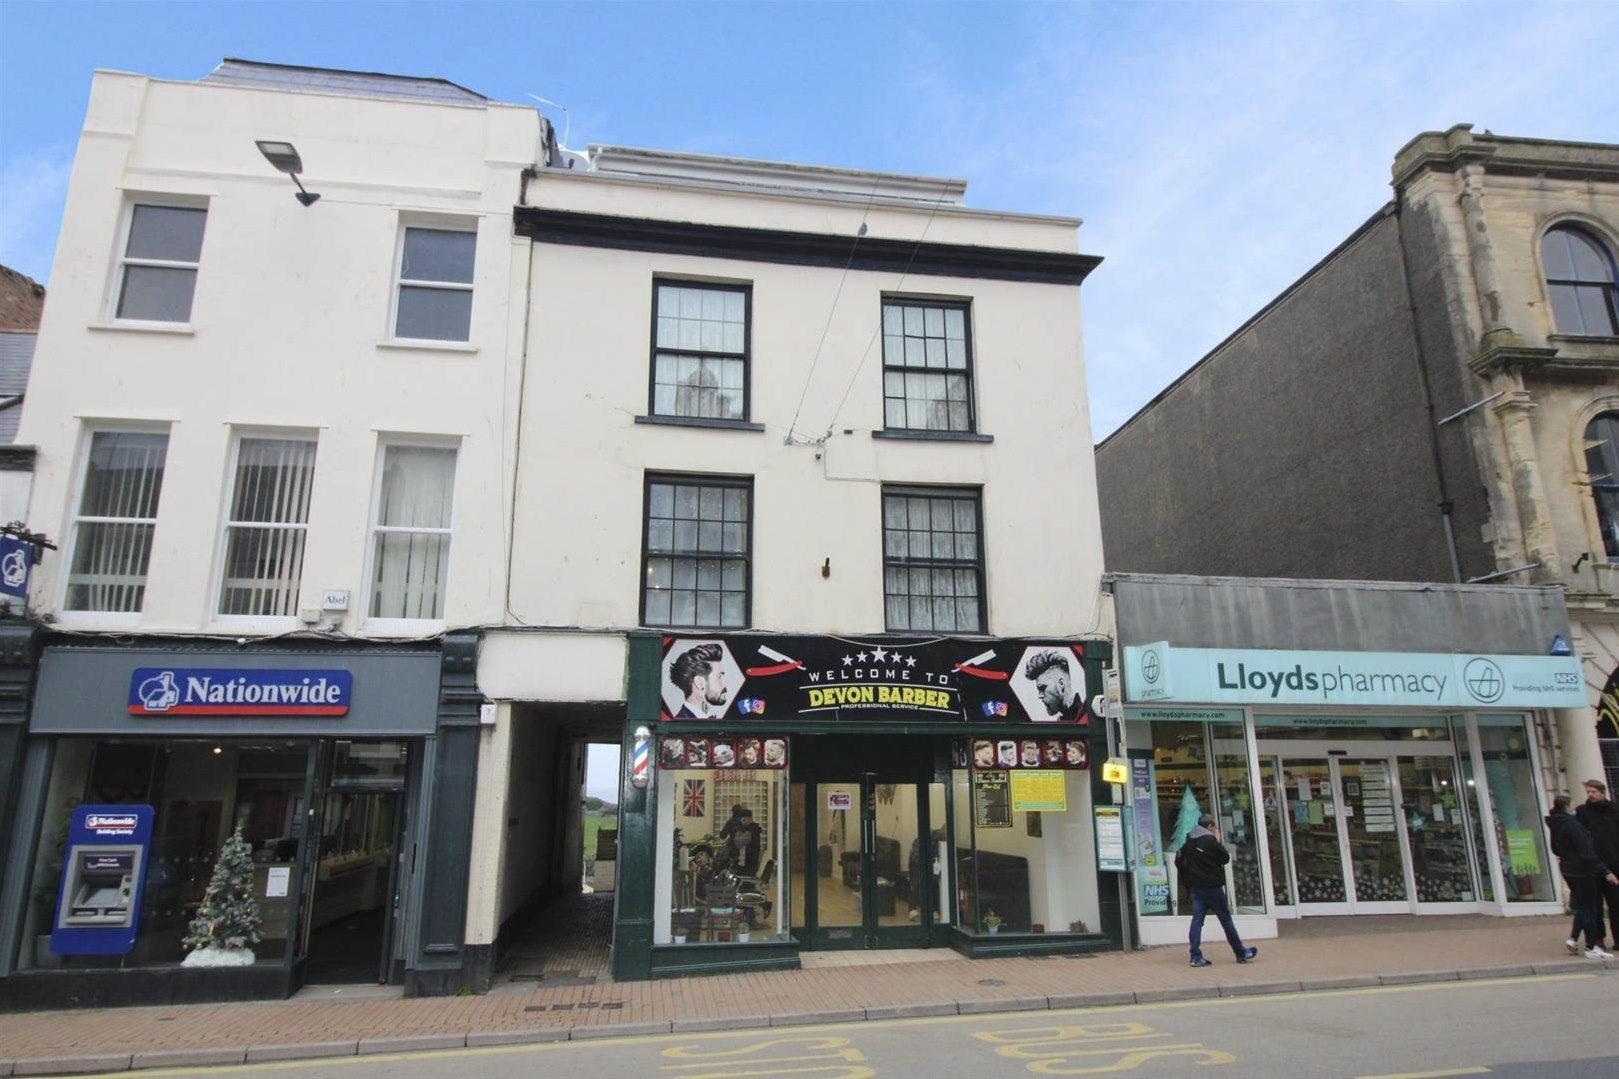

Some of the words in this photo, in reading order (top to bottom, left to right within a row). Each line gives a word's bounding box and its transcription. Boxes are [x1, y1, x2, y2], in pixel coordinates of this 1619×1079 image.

[809, 668, 910, 682] WELCOME
[926, 672, 948, 685] TO
[1217, 662, 1447, 701] Lloydspharmacy
[1556, 673, 1577, 683] NHS
[184, 677, 341, 704] Nationwide
[808, 686, 875, 707] DEVON
[878, 686, 950, 709] BARBER
[891, 703, 919, 711] SERVICE
[1141, 711, 1225, 719] www.lloydspharmacy.com
[98, 817, 135, 825] Nationwide
[1145, 884, 1169, 896] NHS
[1144, 898, 1177, 907] Providg
